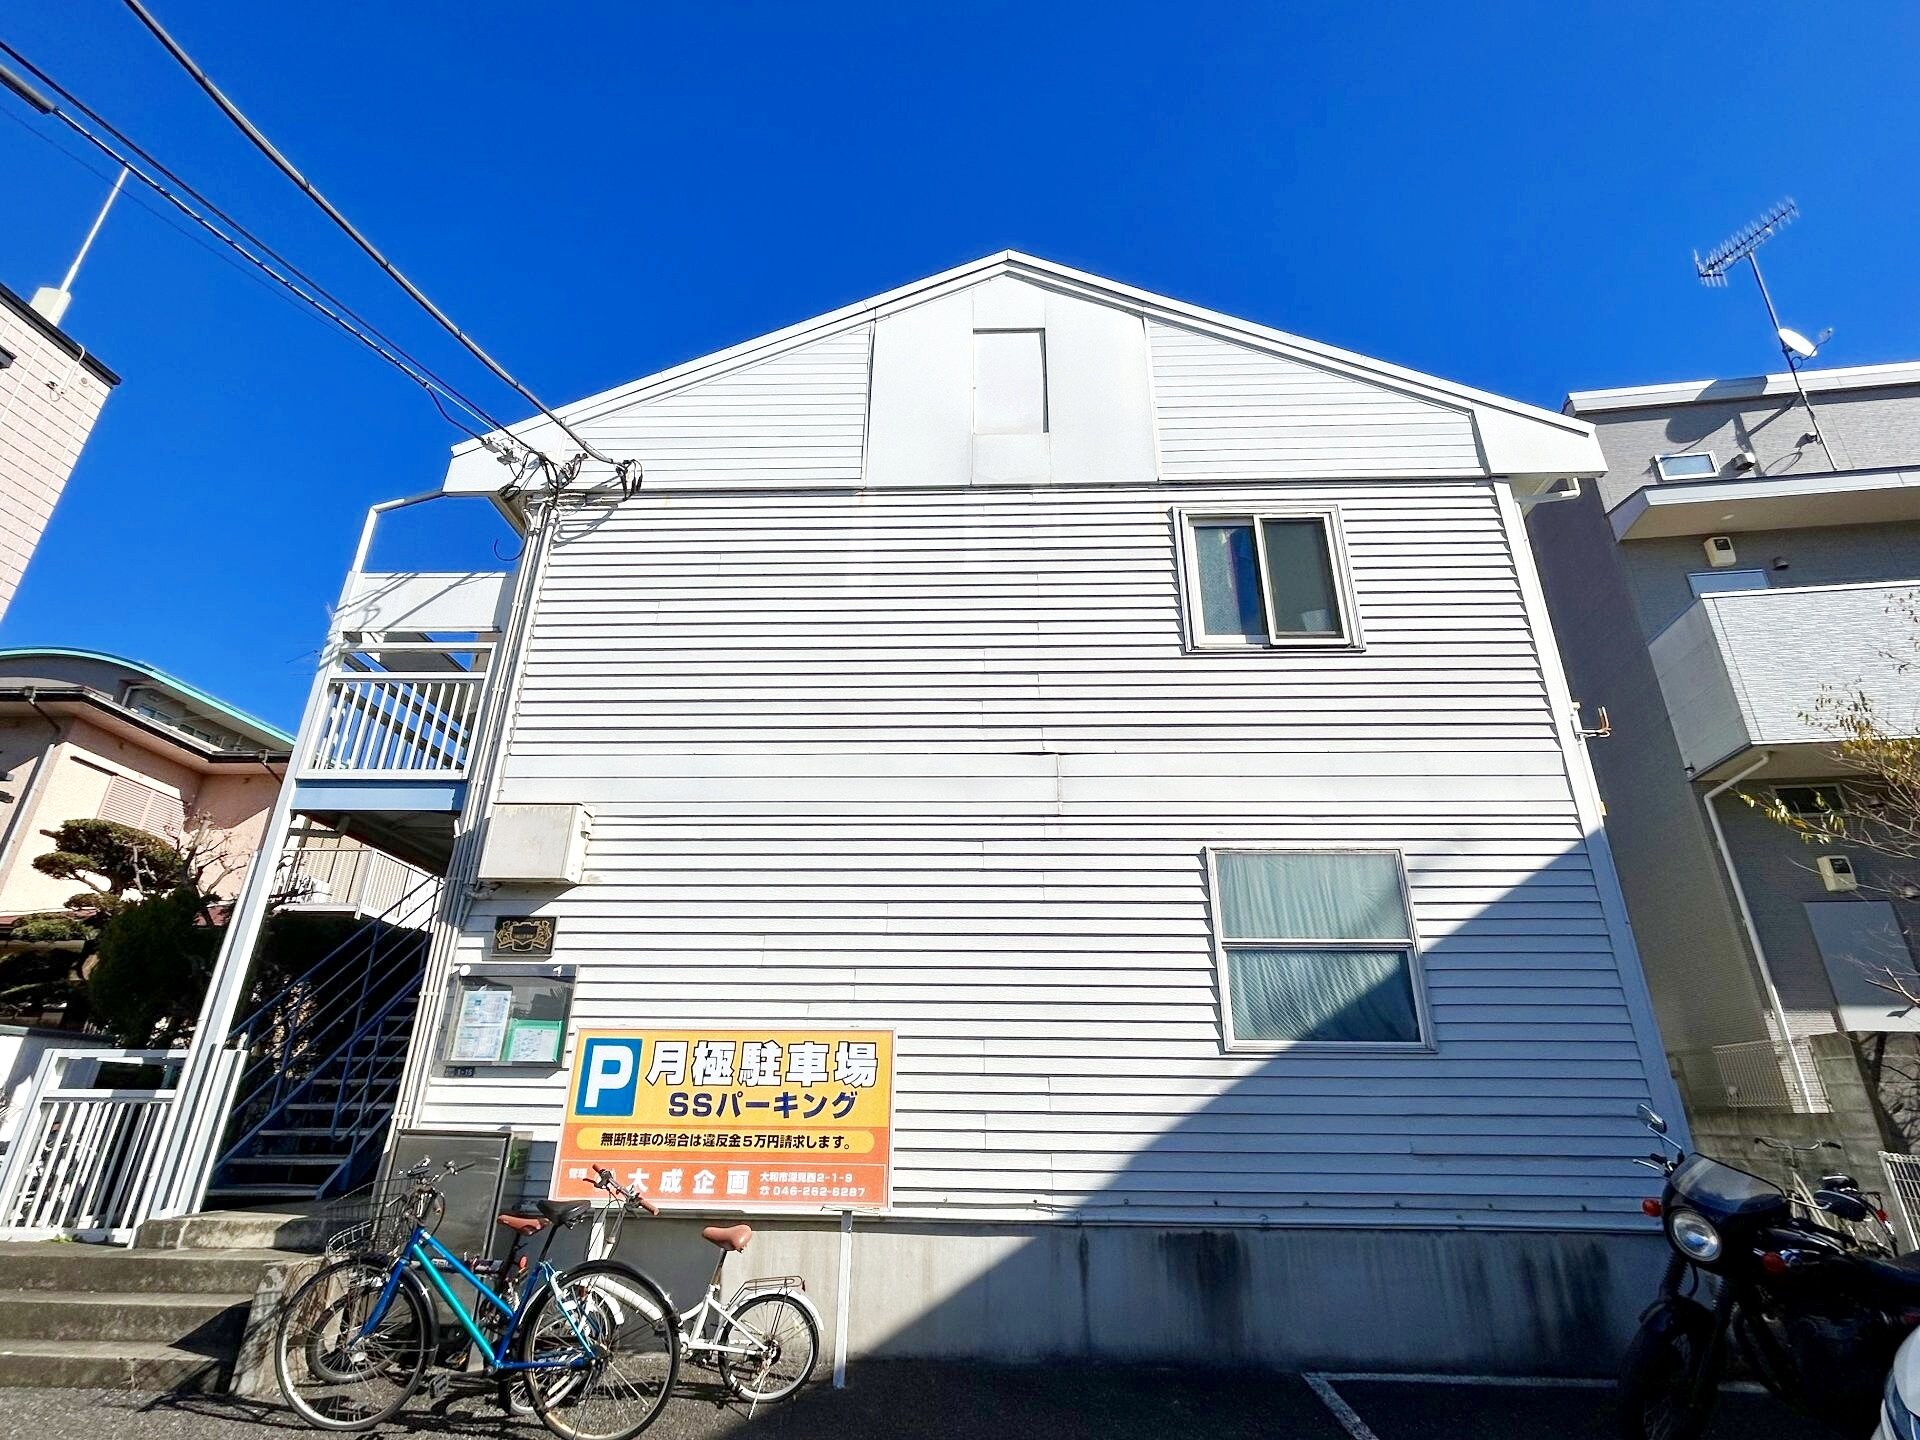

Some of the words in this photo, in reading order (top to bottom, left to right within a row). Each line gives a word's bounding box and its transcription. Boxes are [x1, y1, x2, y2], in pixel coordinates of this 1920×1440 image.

[584, 1045, 634, 1108] P
[645, 1039, 878, 1089] 月極駐車場
[668, 1091, 858, 1119] SSパーキング
[600, 1132, 850, 1150] 無断駐車の場合は違反金5万円請求します。
